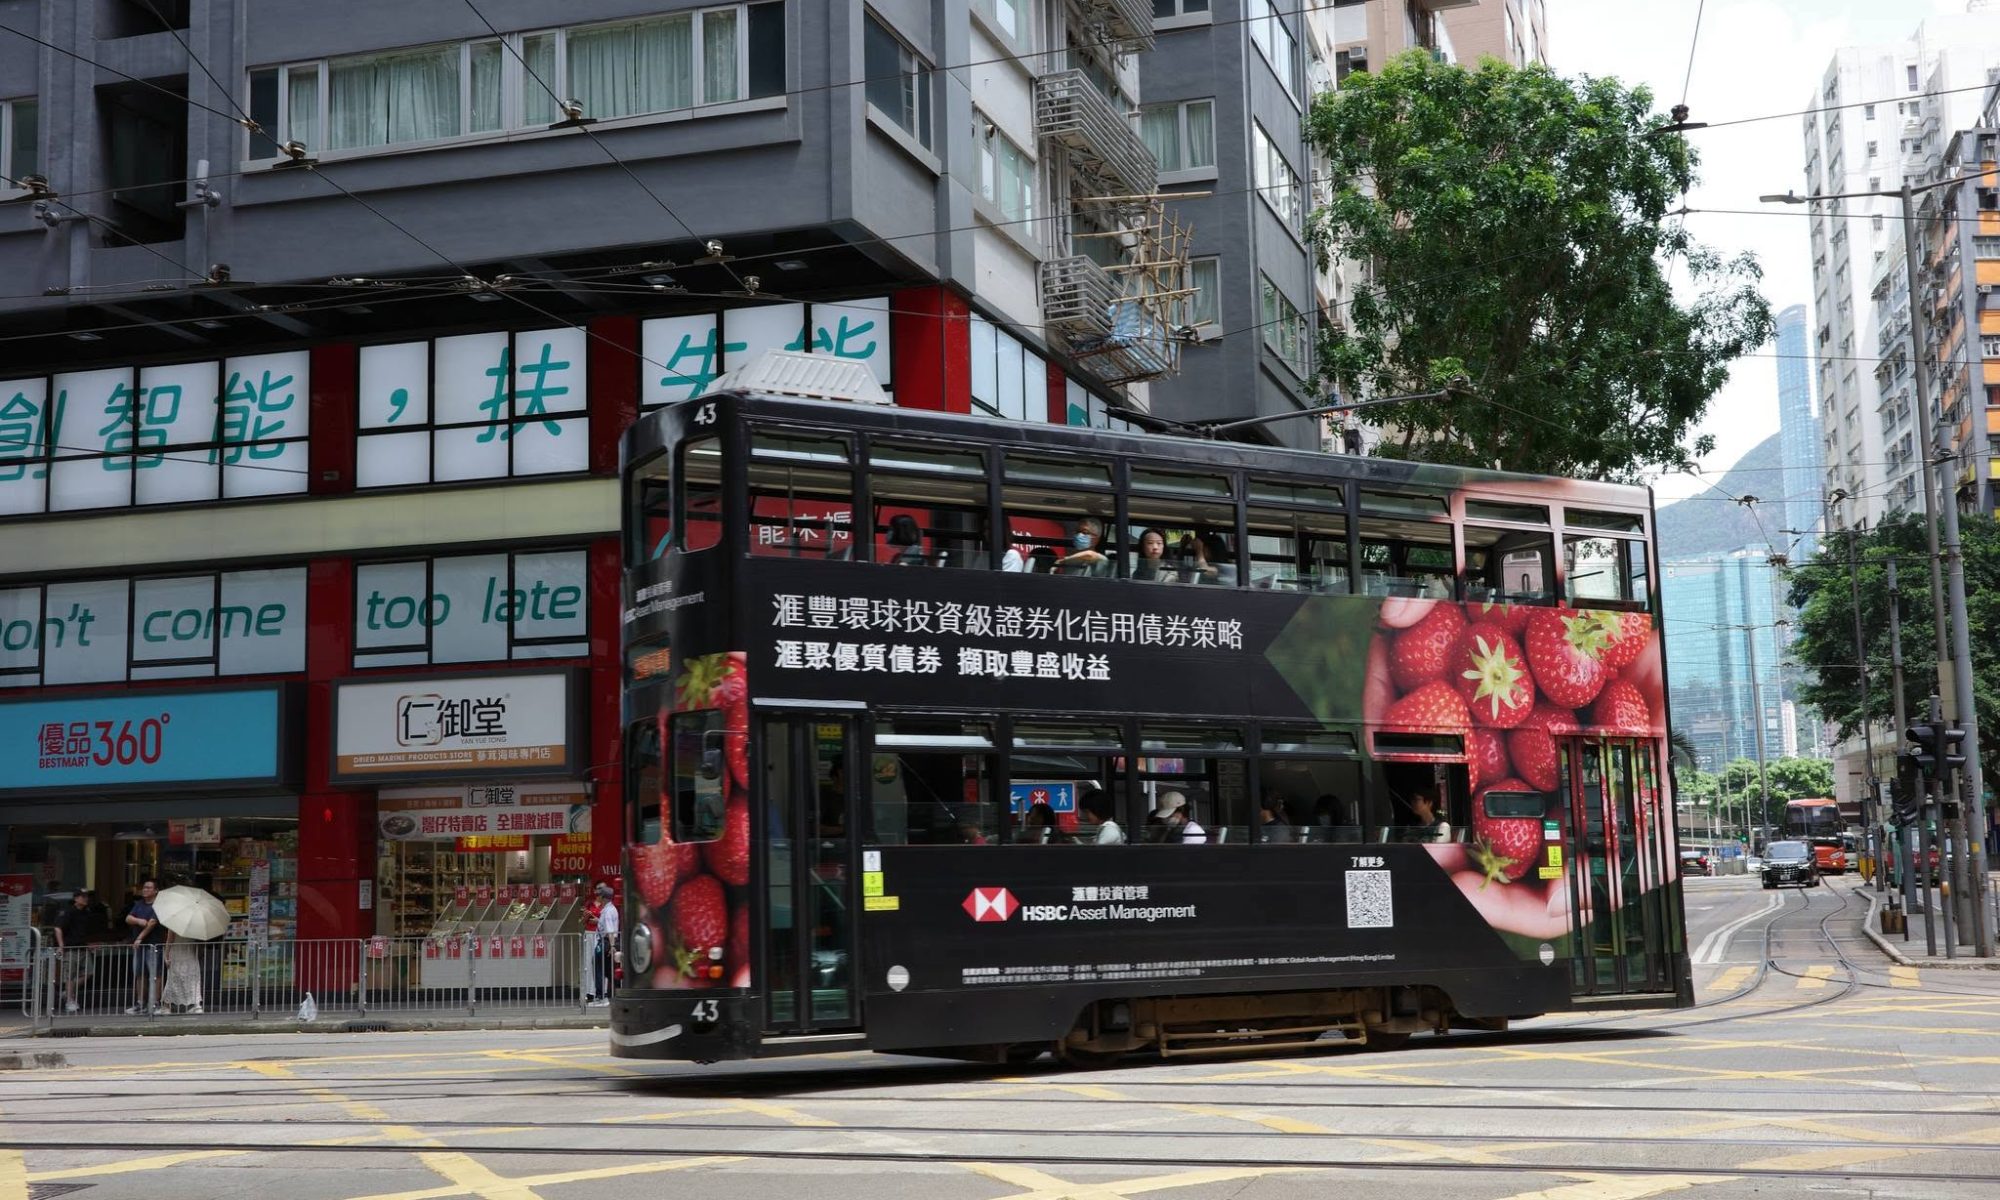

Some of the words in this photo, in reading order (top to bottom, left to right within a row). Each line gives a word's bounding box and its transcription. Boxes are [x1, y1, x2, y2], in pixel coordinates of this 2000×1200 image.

[693, 403, 717, 425] 43
[0, 603, 95, 651] on't
[143, 604, 286, 642] come
[366, 590, 450, 630] too
[481, 577, 581, 624] late
[771, 593, 1244, 650] 滙豐環球投資級證券化信用債券策略
[402, 697, 507, 740] 仁御堂
[38, 722, 91, 756] 優品
[39, 756, 90, 769] BESTMART
[353, 756, 375, 764] DRIED
[378, 754, 405, 762] MARINE
[408, 752, 447, 761] PRODUCTS
[450, 751, 472, 759] STORE
[553, 857, 585, 870] $100
[1022, 905, 1068, 922] HSBC
[1069, 905, 1108, 920] Asset
[1109, 904, 1196, 922] Management
[691, 999, 720, 1022] 43
